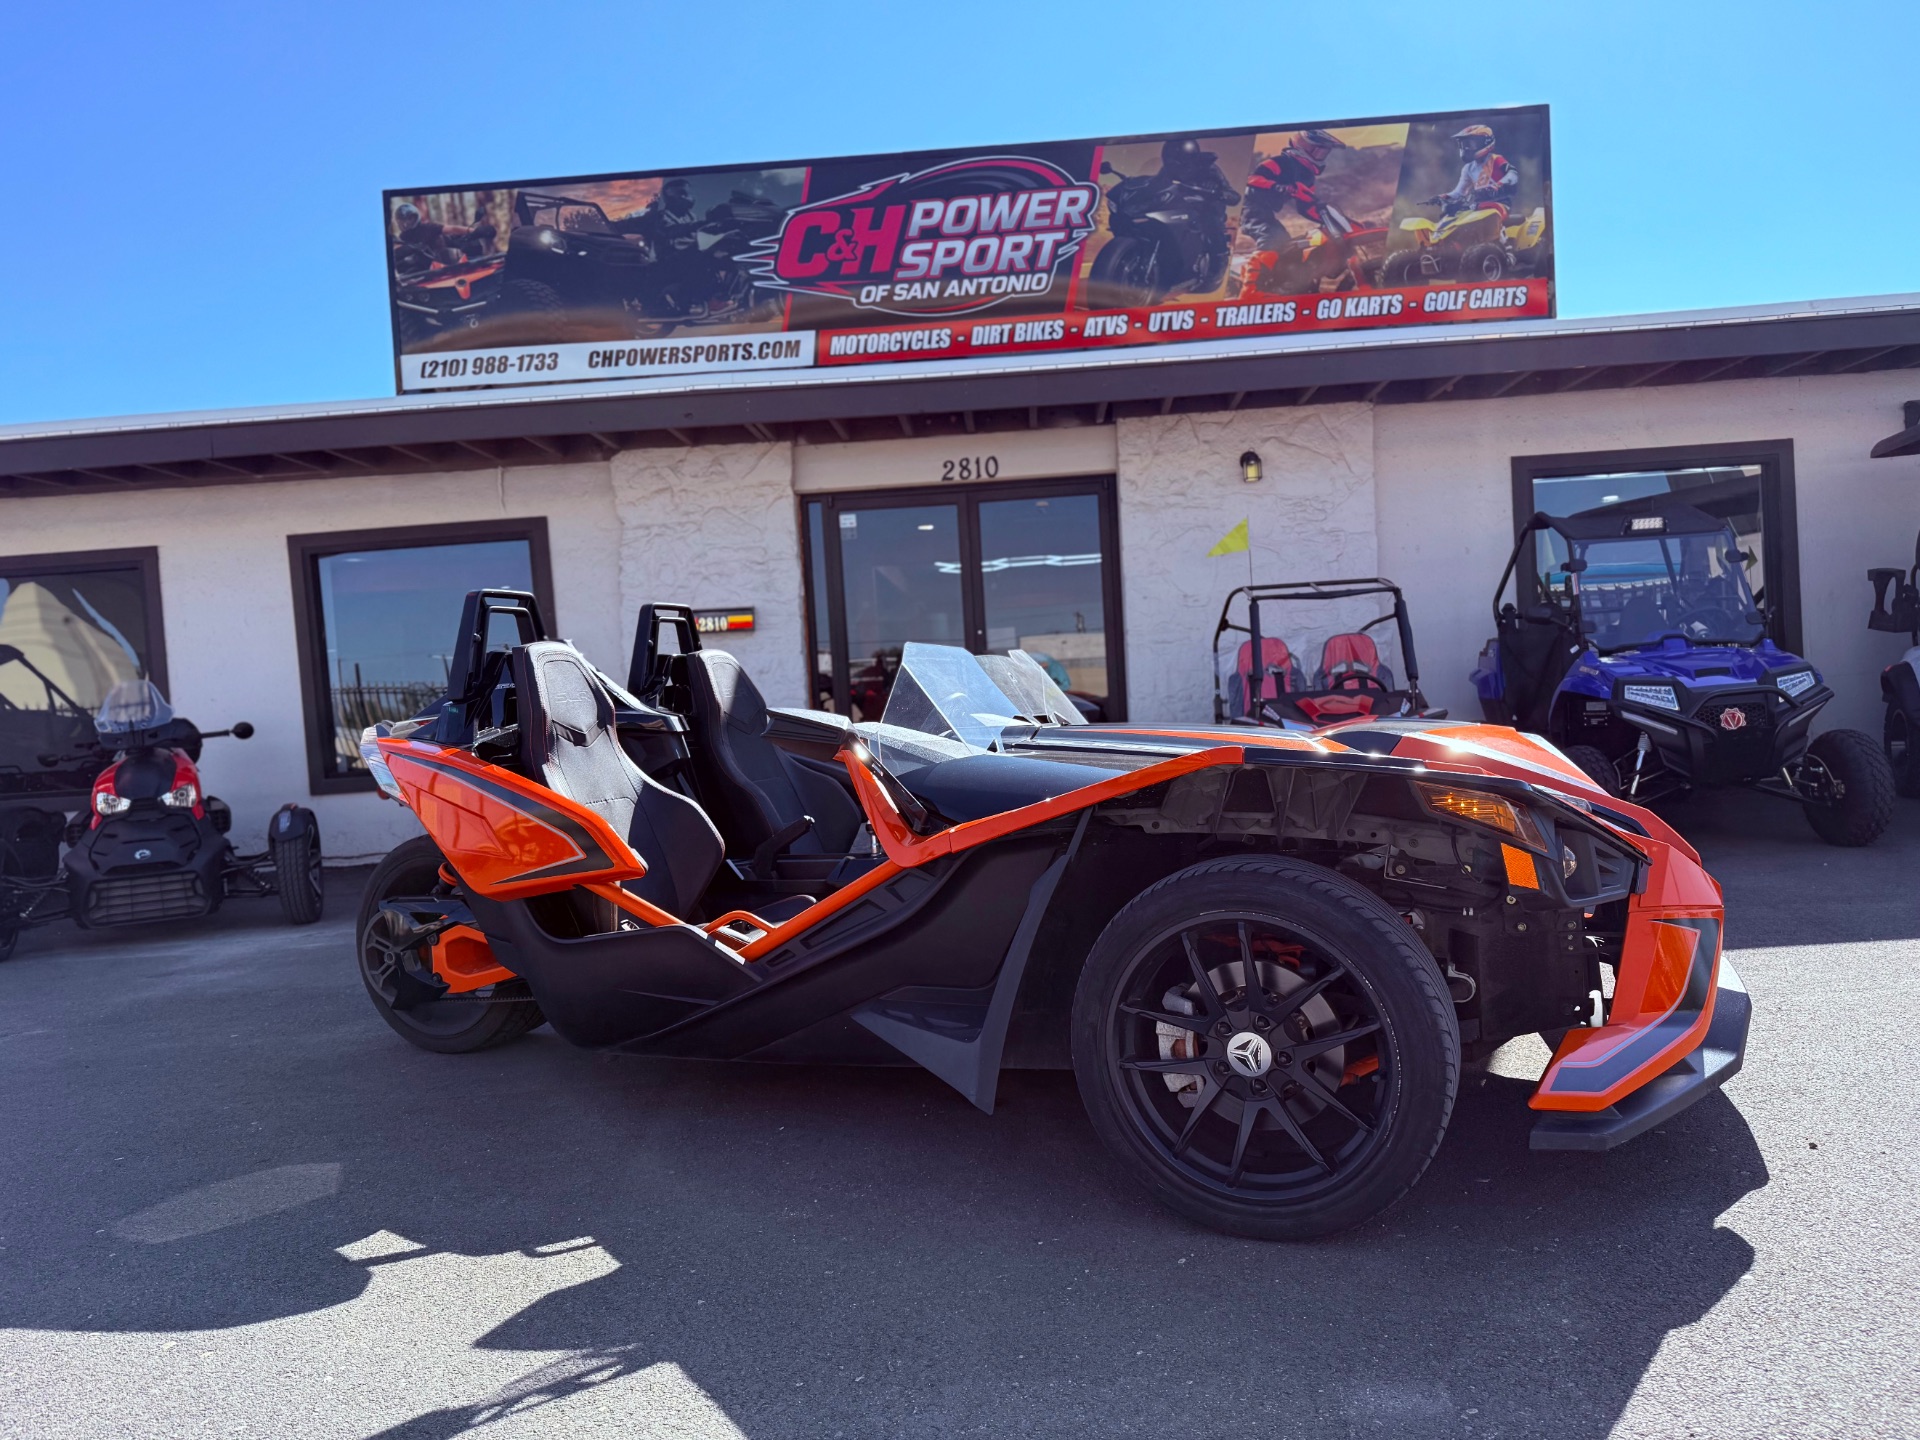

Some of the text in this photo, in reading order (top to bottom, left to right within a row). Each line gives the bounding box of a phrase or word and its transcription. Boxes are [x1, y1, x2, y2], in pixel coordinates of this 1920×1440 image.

[907, 188, 1091, 239] POWER
[776, 204, 907, 278] C&H
[895, 230, 1068, 279] SPORT
[860, 273, 1049, 304] OF SAN ANTONIO
[829, 328, 952, 356] MOTORCYCLES
[970, 323, 1013, 347] DIRT
[1013, 319, 1065, 344] BIKES
[1083, 314, 1129, 338] ATVS
[1147, 309, 1195, 333] UTVS
[1215, 301, 1297, 328] TRAILERS
[1315, 298, 1341, 320] GO
[1343, 294, 1403, 317] KARTS
[1423, 290, 1467, 313] GOLF
[1470, 286, 1528, 309] CARTS
[420, 352, 559, 379] (210) 988-1733
[588, 340, 801, 369] CHPOWERSPORTS.COM
[941, 455, 999, 481] 2810
[698, 616, 728, 632] 2810
